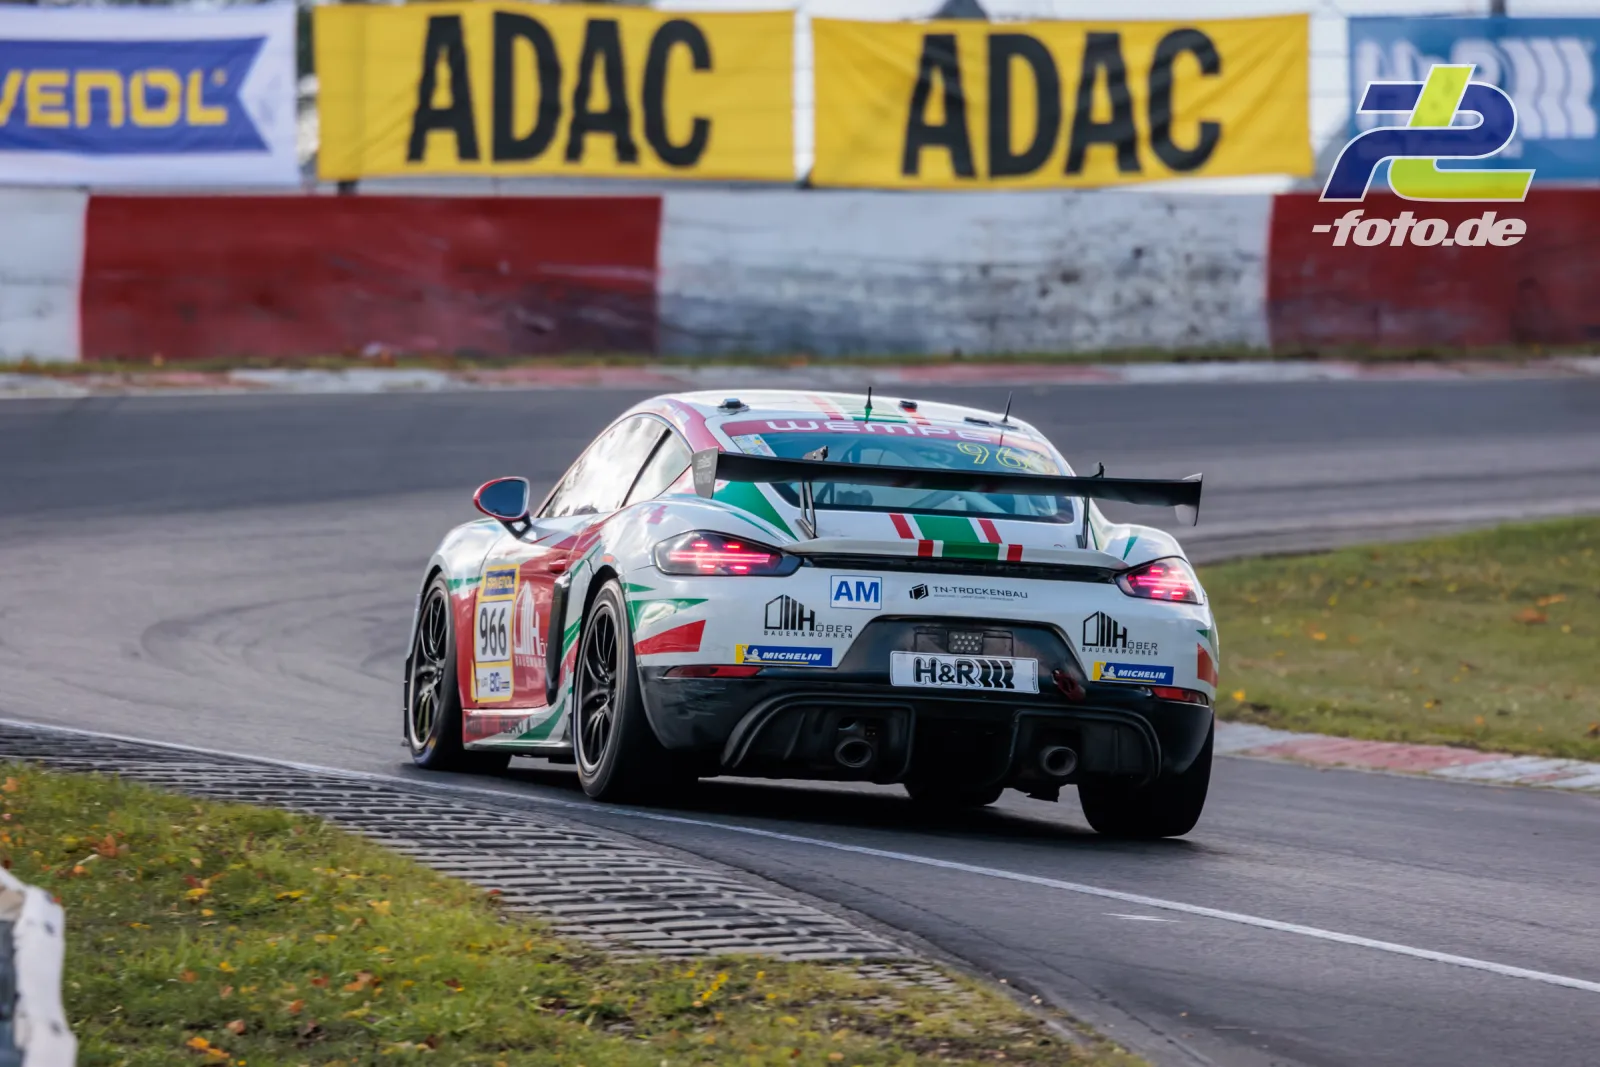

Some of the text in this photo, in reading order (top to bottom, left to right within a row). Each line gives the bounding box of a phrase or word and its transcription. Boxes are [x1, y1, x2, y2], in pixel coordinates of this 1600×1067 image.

[405, 11, 714, 168] ADAC
[902, 27, 1223, 180] ADAC
[766, 421, 991, 442] WEMPE
[833, 581, 880, 603] AM
[933, 586, 1028, 599] TN-TROCKENBAU
[480, 606, 508, 657] 966
[762, 651, 822, 661] MICHELIN
[914, 657, 984, 687] H&R
[1117, 669, 1167, 680] MICHELIN
